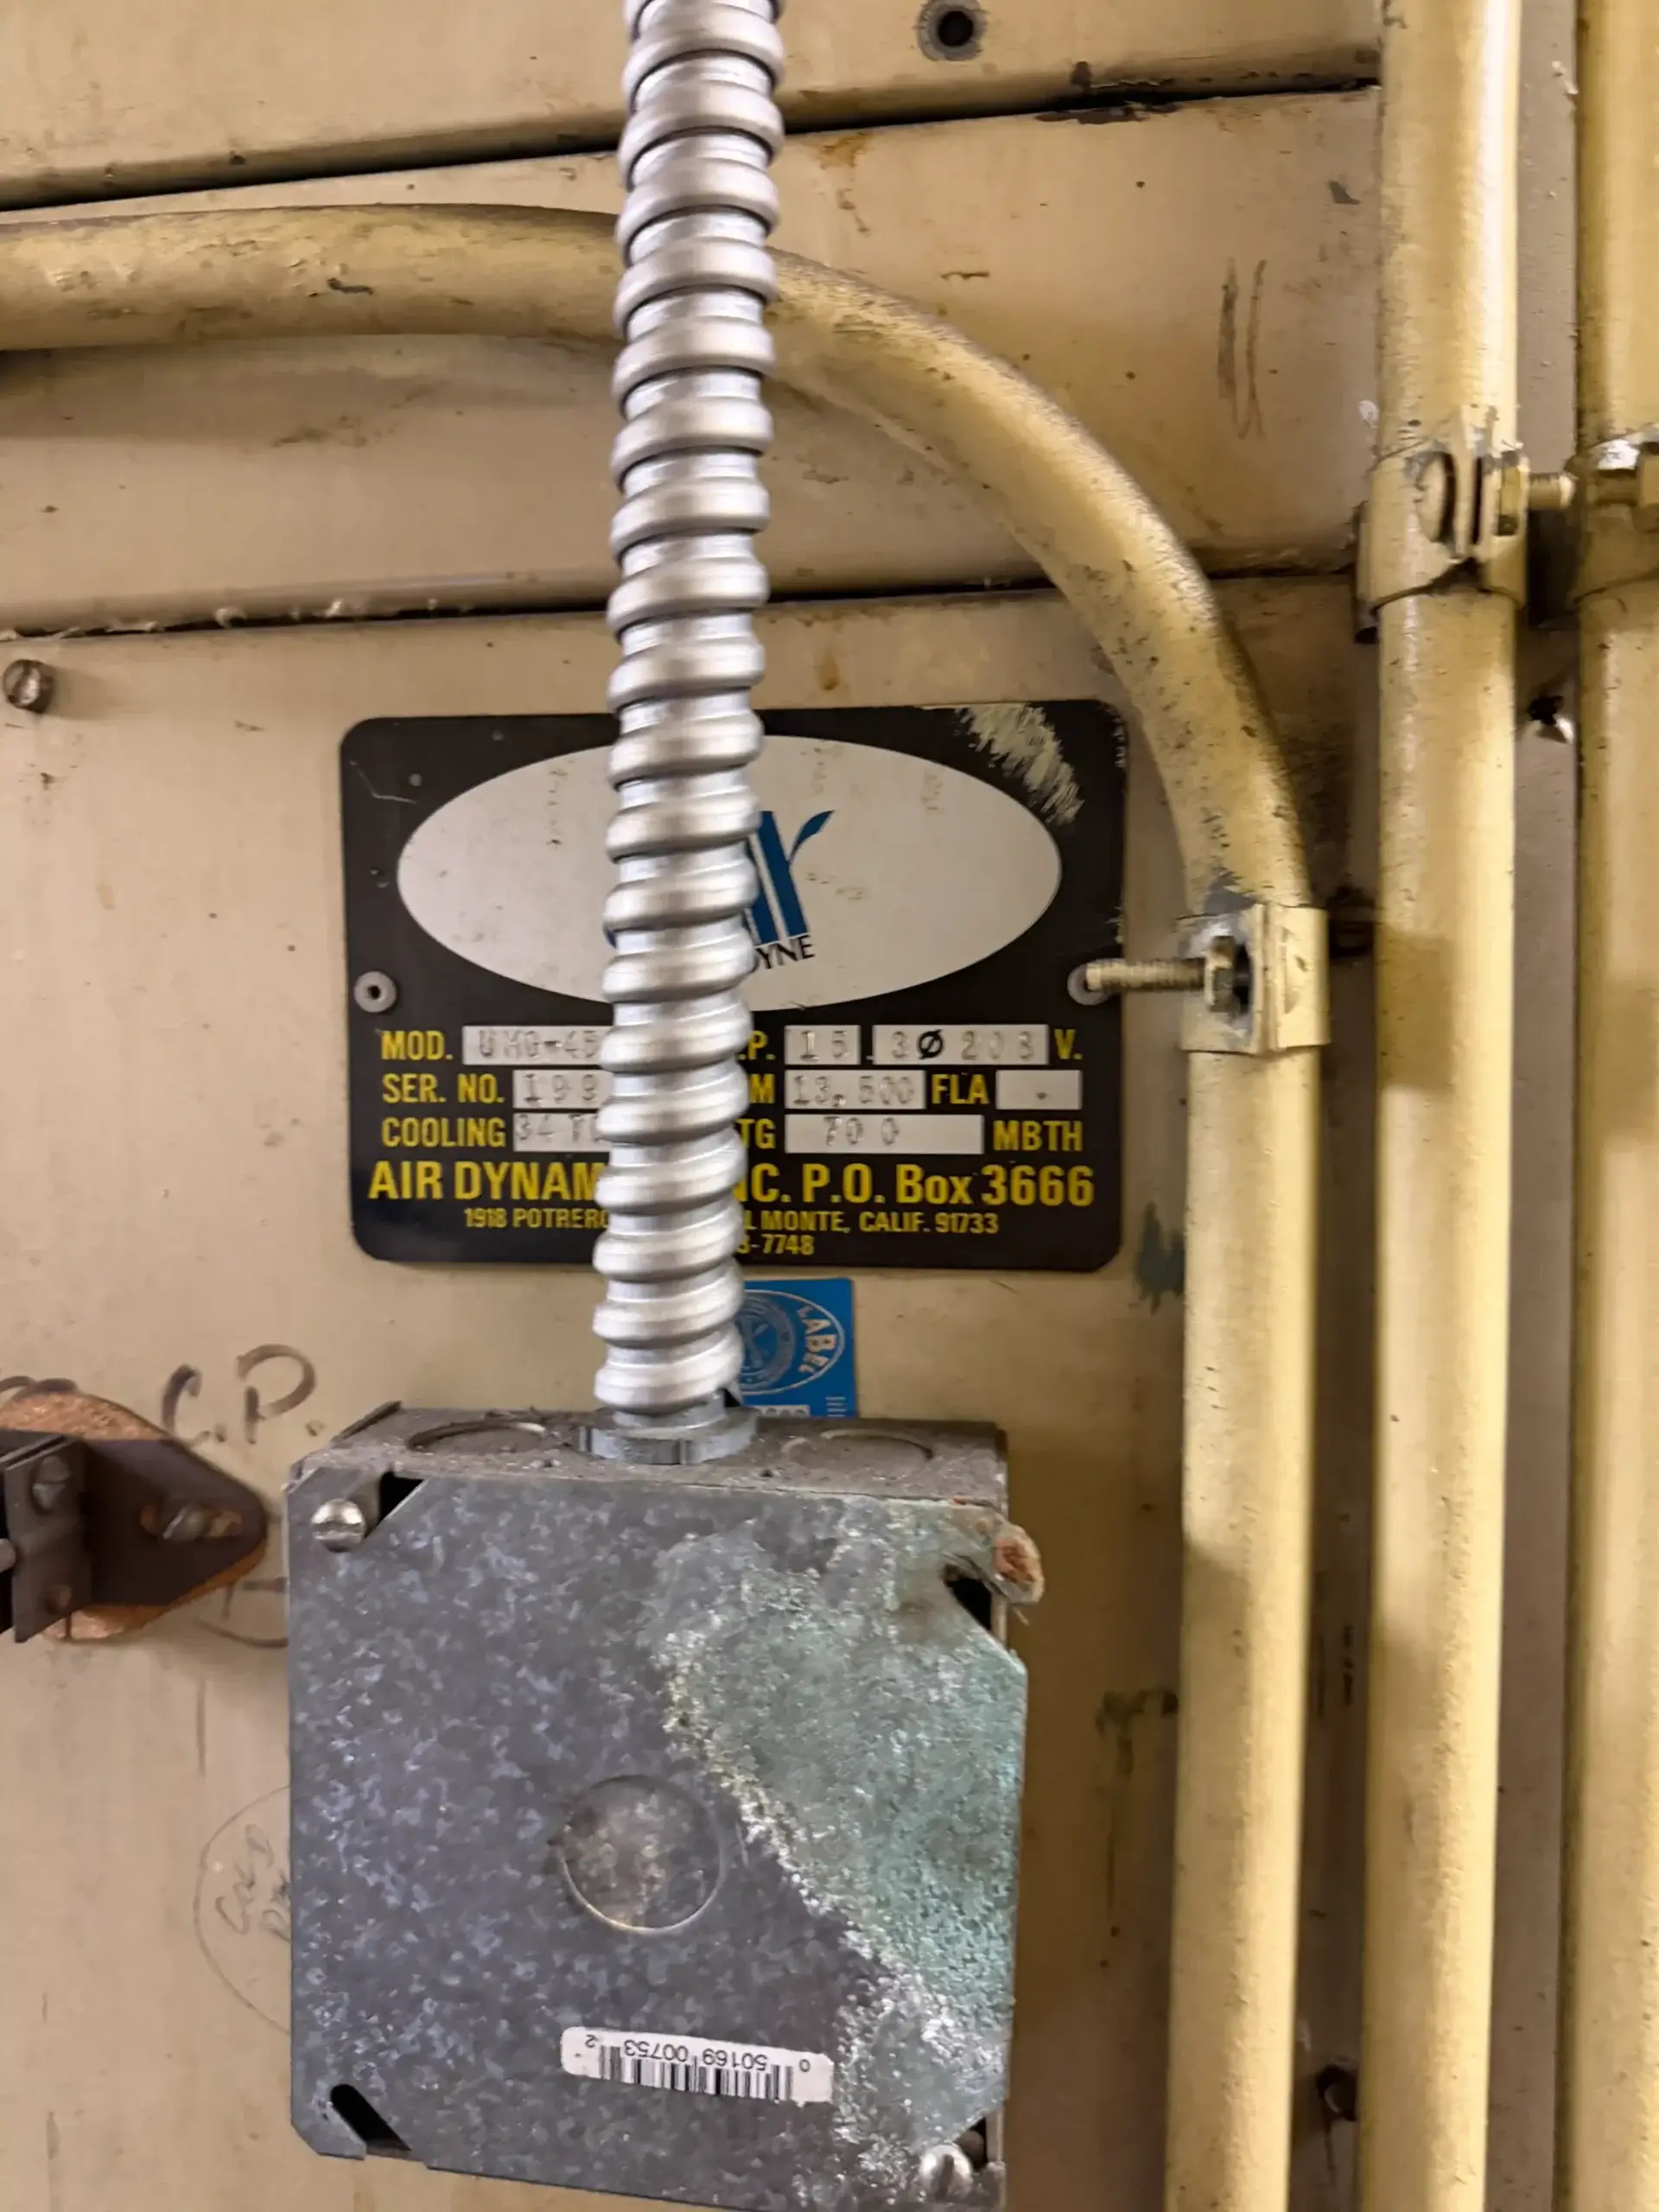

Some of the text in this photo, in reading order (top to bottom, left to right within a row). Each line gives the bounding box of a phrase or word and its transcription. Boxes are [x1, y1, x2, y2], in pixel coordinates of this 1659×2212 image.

[750, 934, 816, 970] YNE
[379, 1030, 454, 1061] MOD.
[801, 1030, 849, 1061] 15
[1054, 1029, 1083, 1060] V.
[382, 1073, 446, 1104] SER.
[457, 1073, 504, 1104] NO.
[931, 1074, 989, 1104] FLA
[381, 1116, 506, 1147] COOLING
[735, 1118, 776, 1150] TG
[993, 1120, 1083, 1152] MBTH
[368, 1160, 443, 1199] AIR
[454, 1161, 607, 1201] DYNAM
[803, 1163, 886, 1203] P.O.
[896, 1164, 974, 1205] Box
[982, 1165, 1095, 1206] 3666
[465, 1208, 508, 1229] 1918
[859, 1211, 931, 1233] CALIF.
[935, 1212, 999, 1234] 91733
[584, 2033, 812, 2073] 0 50169 00753 2
